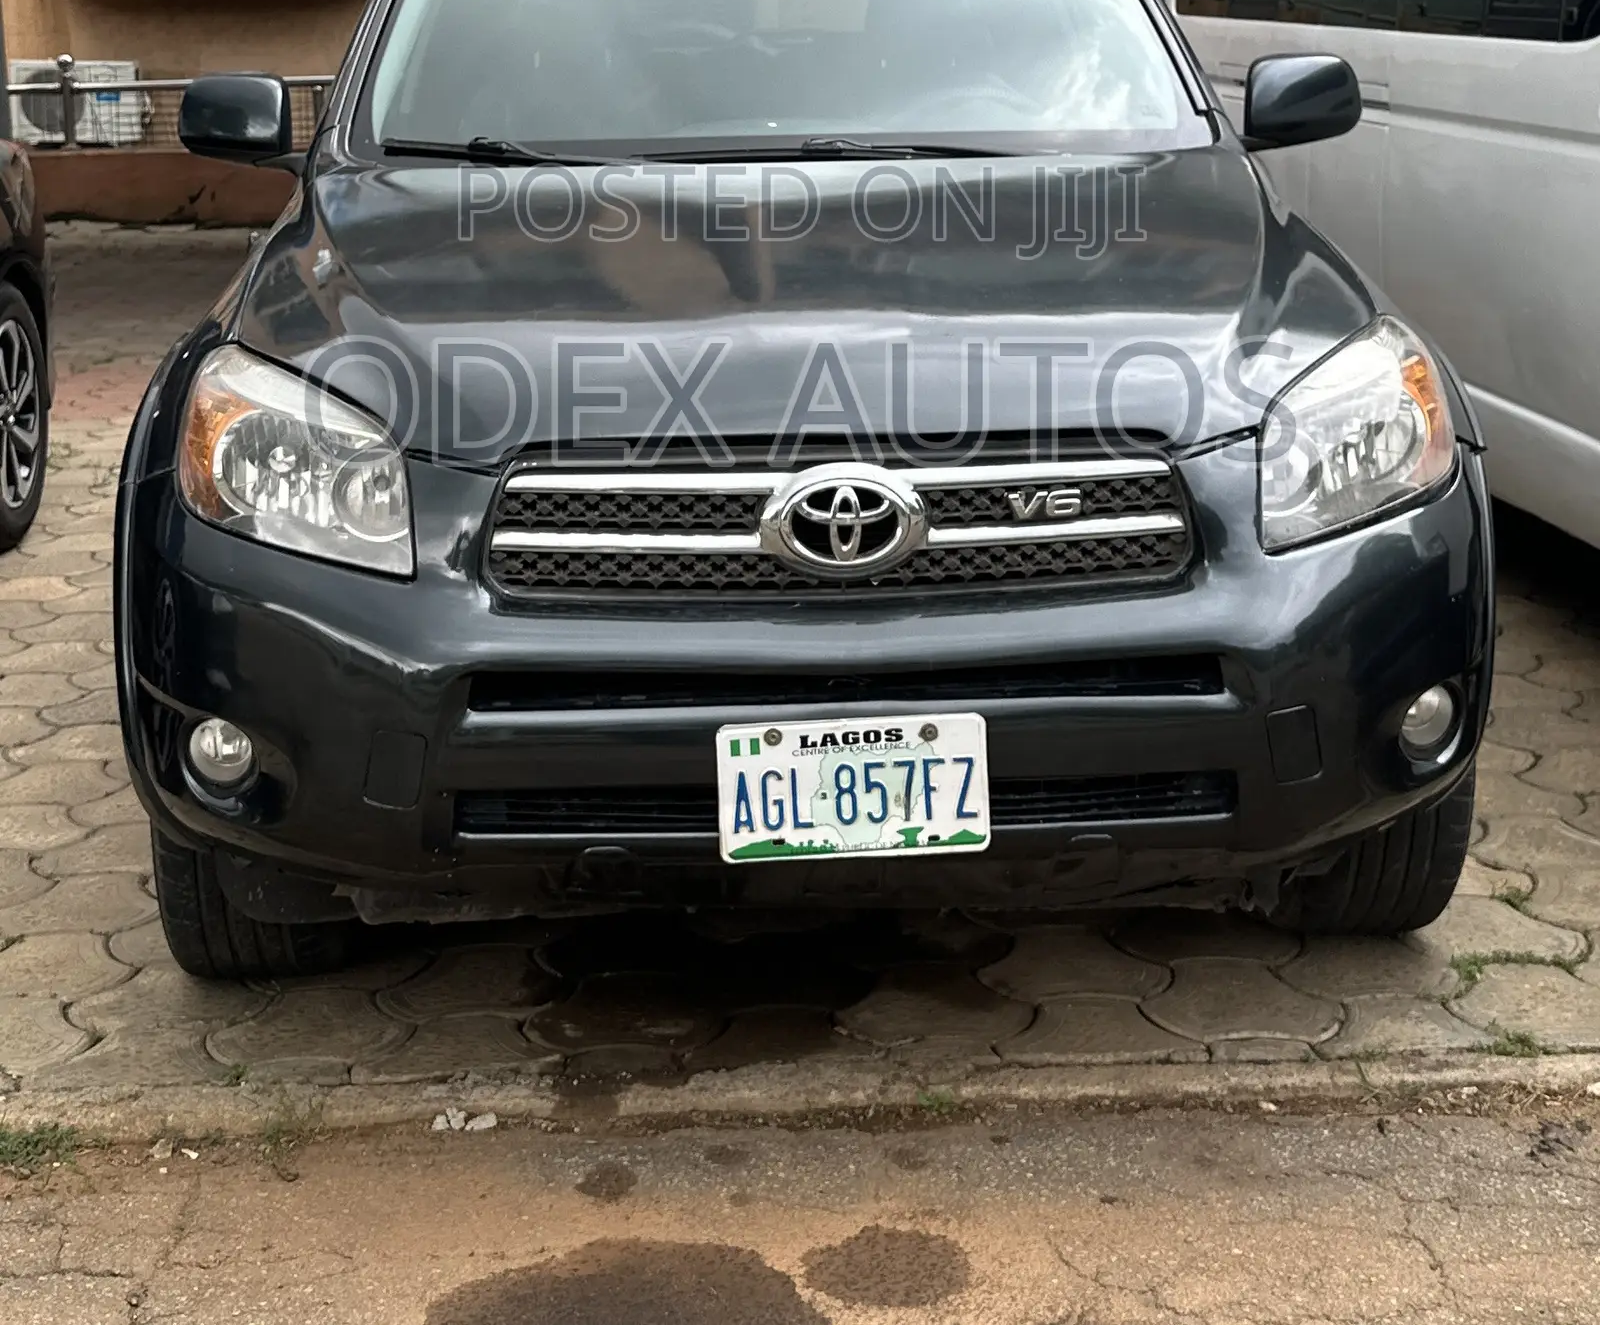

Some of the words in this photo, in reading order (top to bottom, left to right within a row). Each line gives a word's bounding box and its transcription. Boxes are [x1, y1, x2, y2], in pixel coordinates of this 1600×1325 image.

[1008, 488, 1081, 520] V6
[792, 746, 829, 757] CENTRE
[832, 746, 846, 754] OF
[848, 741, 911, 753] EXCELLENCE
[799, 727, 904, 749] LAGOS
[733, 767, 814, 834] AGL
[834, 756, 979, 826] 857FZ
